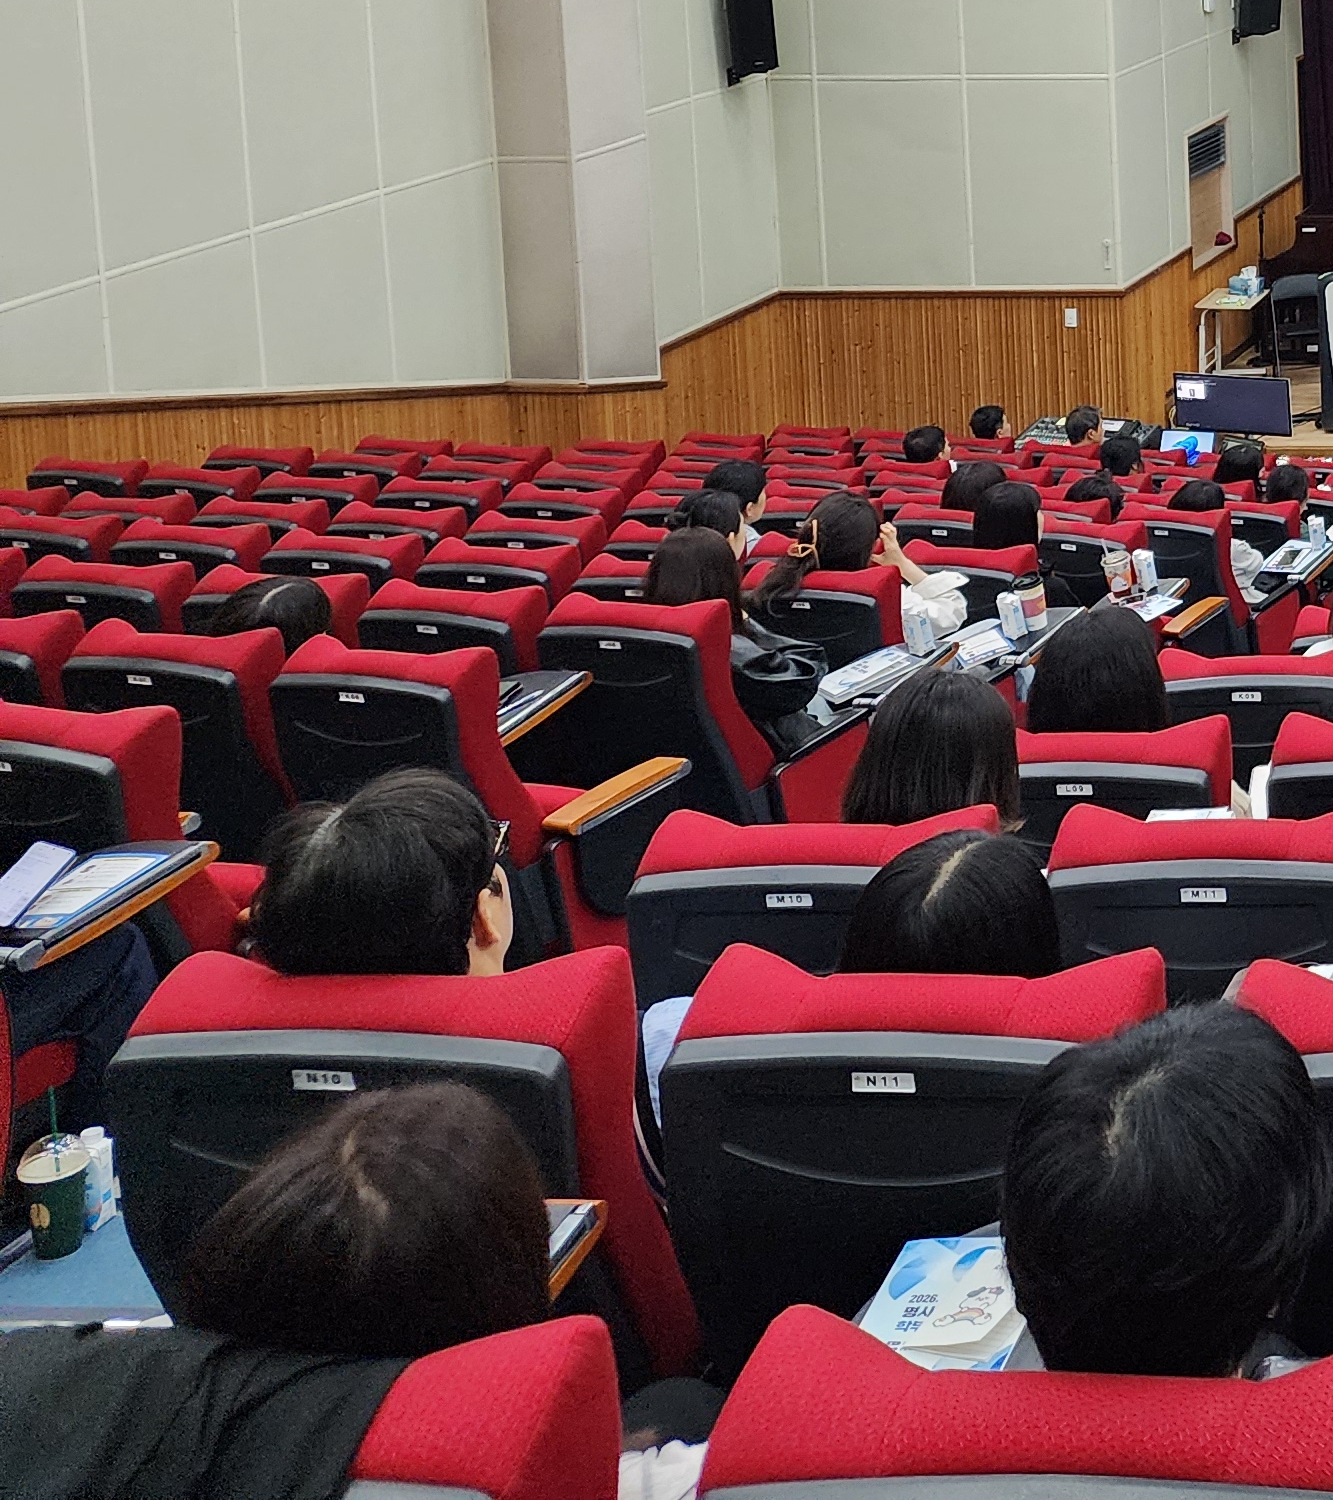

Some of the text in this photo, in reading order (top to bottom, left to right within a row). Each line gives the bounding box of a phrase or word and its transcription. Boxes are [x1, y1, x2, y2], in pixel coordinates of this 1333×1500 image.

[1065, 783, 1084, 792] L09
[776, 895, 803, 904] M10
[1190, 890, 1216, 899] M11
[305, 1073, 341, 1085] N10
[866, 1075, 899, 1088] N11
[908, 1293, 939, 1304] 2026.
